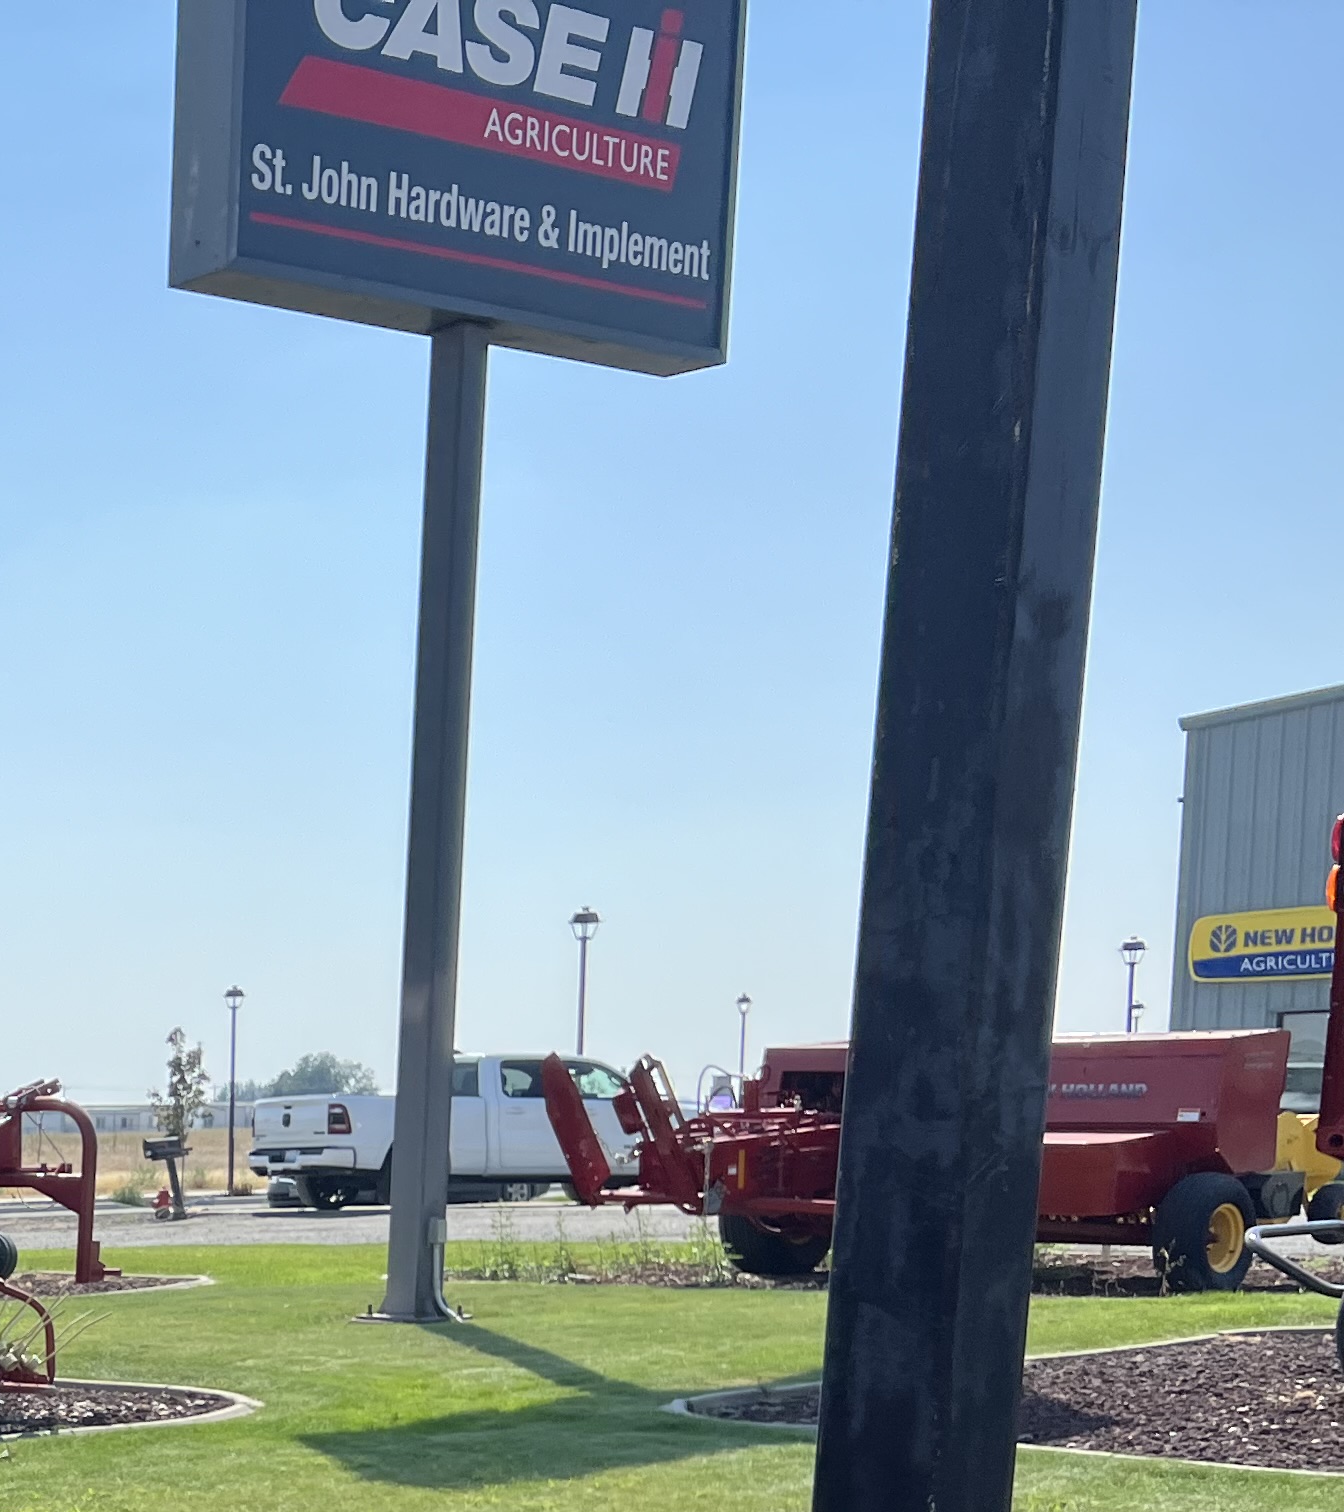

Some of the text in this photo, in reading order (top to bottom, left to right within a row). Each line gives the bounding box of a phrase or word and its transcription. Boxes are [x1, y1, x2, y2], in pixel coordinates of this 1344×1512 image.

[483, 106, 671, 182] AGRICULTURE
[250, 143, 711, 282] St. John Hardware & Implement
[1243, 928, 1296, 948] NEW
